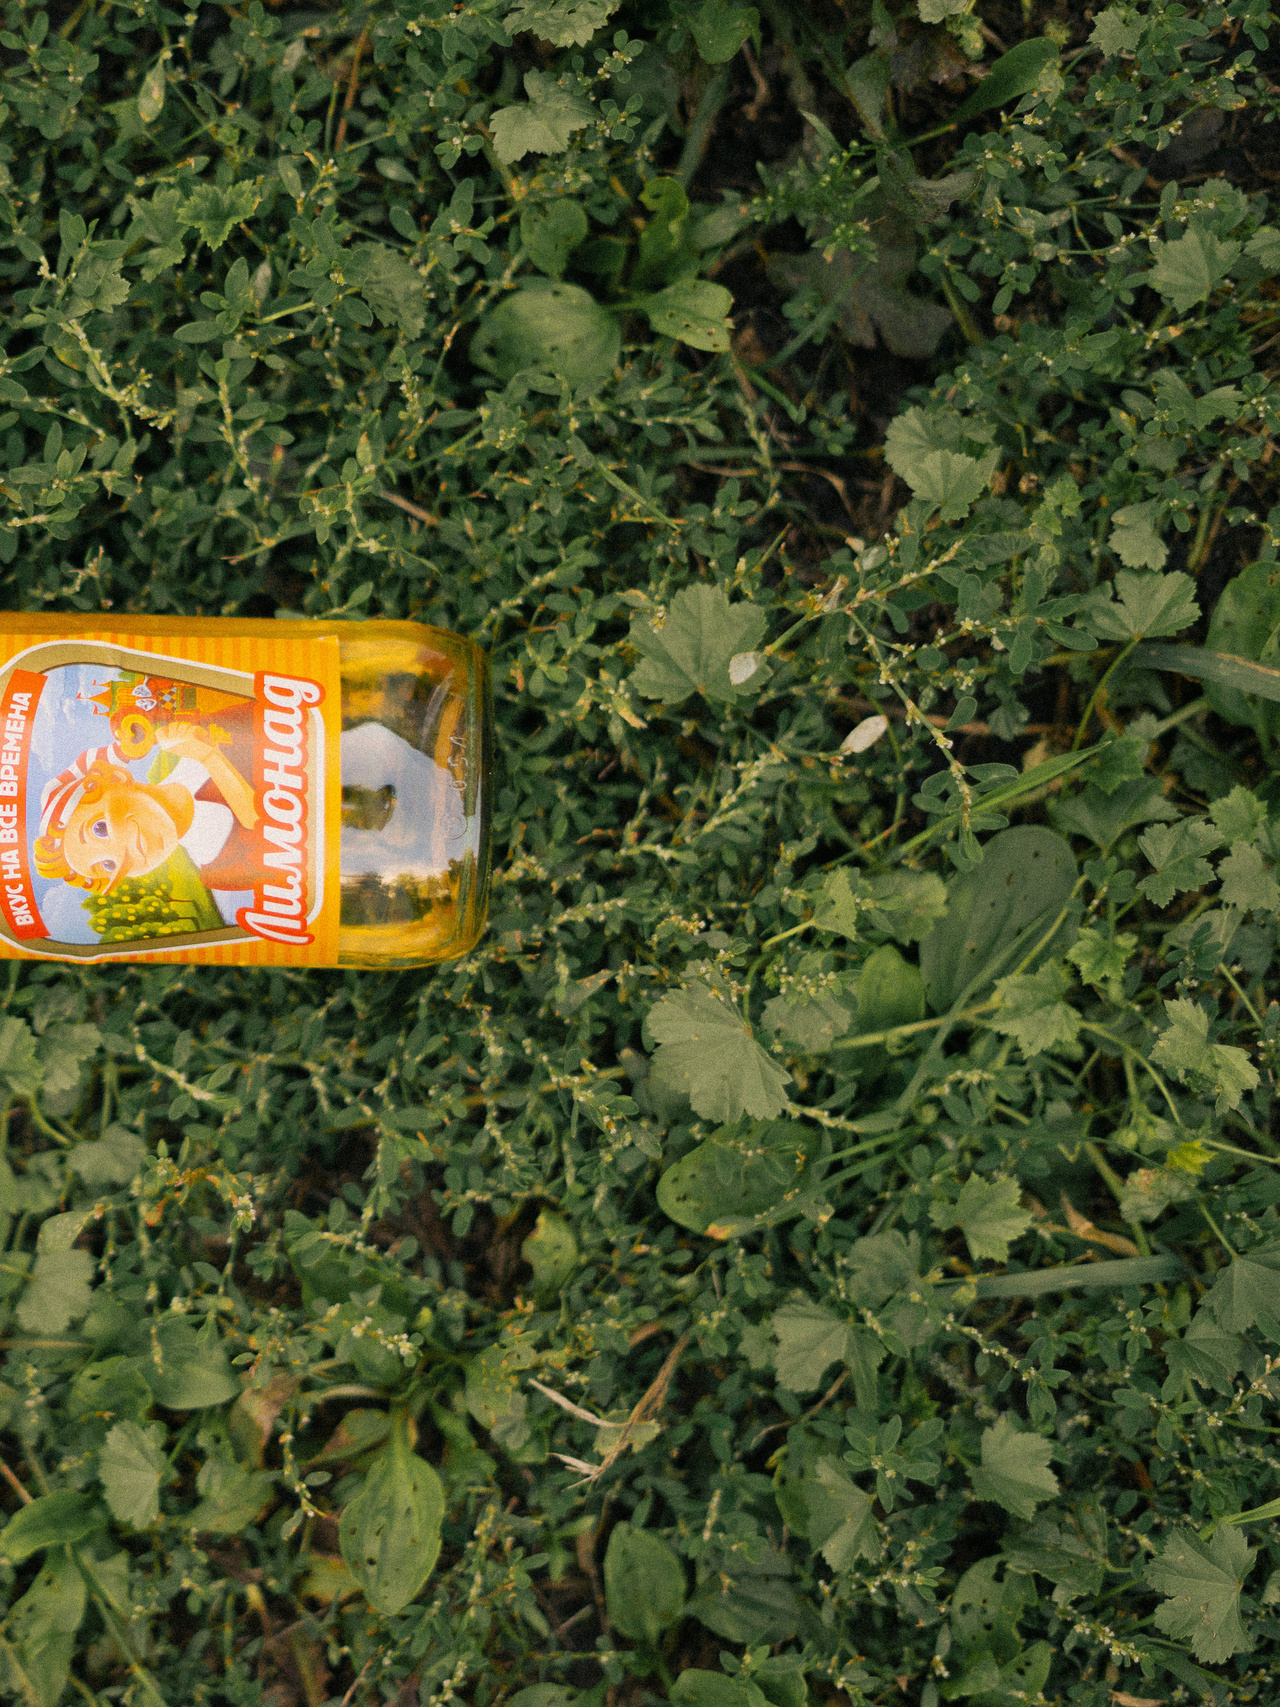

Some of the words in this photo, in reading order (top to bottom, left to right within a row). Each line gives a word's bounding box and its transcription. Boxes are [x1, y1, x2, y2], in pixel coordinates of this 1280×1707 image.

[0, 692, 33, 797] ВРЕМЕНА
[244, 674, 321, 943] Лимонад
[0, 848, 22, 880] НА
[5, 883, 35, 926] ВКУС
